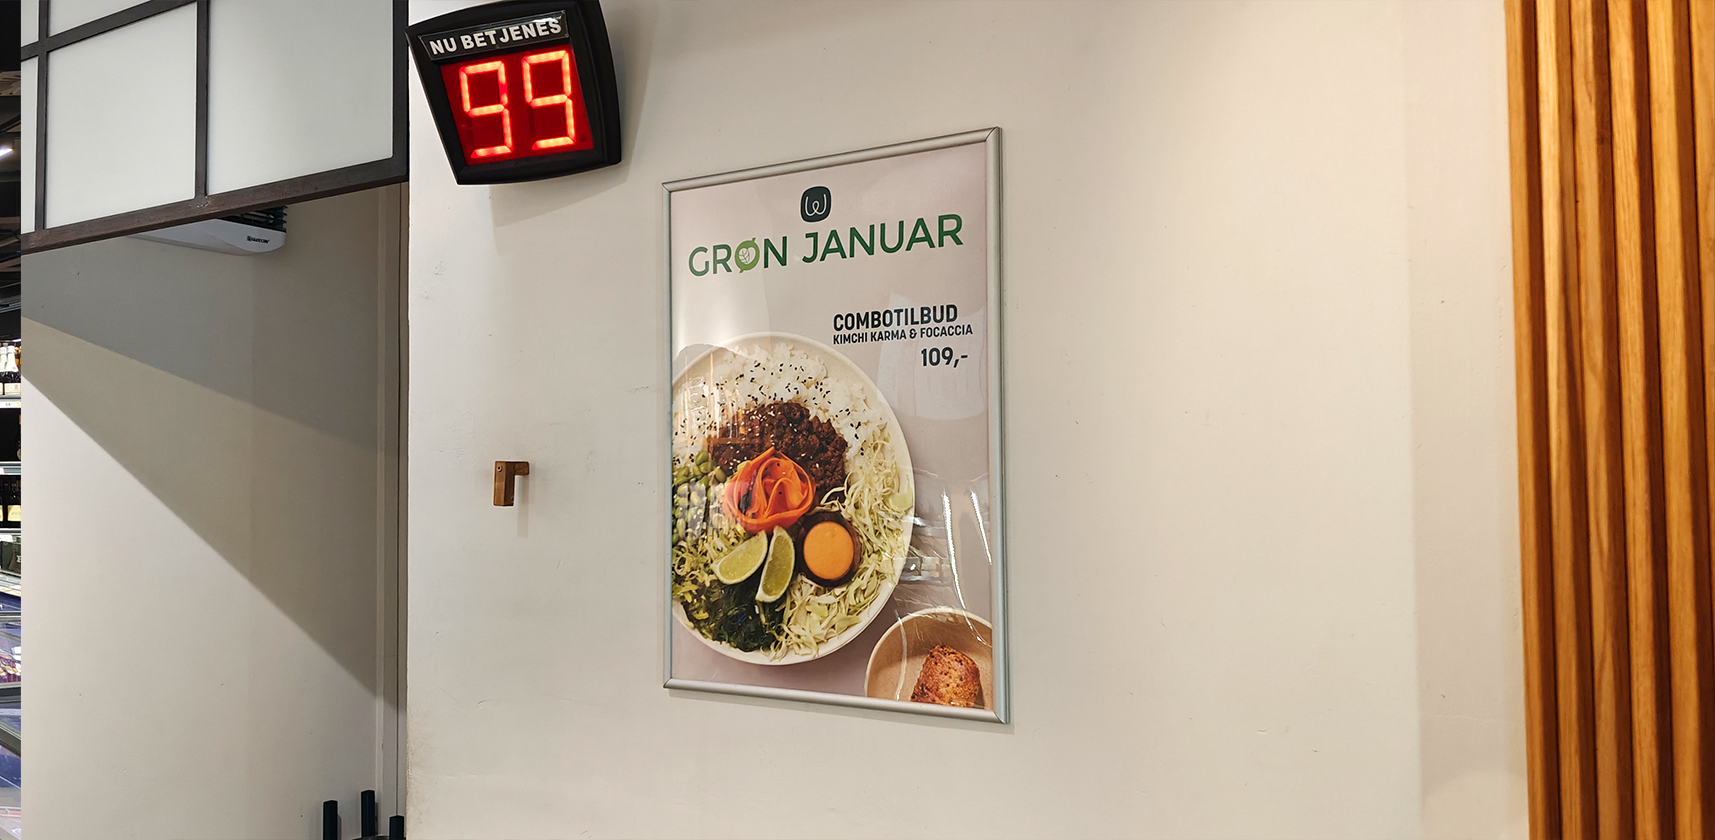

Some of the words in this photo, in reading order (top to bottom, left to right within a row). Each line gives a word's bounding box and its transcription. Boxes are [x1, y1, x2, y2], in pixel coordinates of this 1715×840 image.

[429, 37, 457, 55] NU
[460, 19, 562, 50] BETJENES
[458, 50, 575, 159] 99
[688, 235, 787, 277] GRØN
[801, 213, 964, 264] JANUAR
[833, 304, 958, 332] COMBOTILBUD
[833, 332, 868, 345] KIMCHI
[870, 330, 907, 343] KARMA
[909, 328, 917, 340] &
[920, 324, 973, 339] FOCACCIA
[920, 346, 968, 369] 109,-
